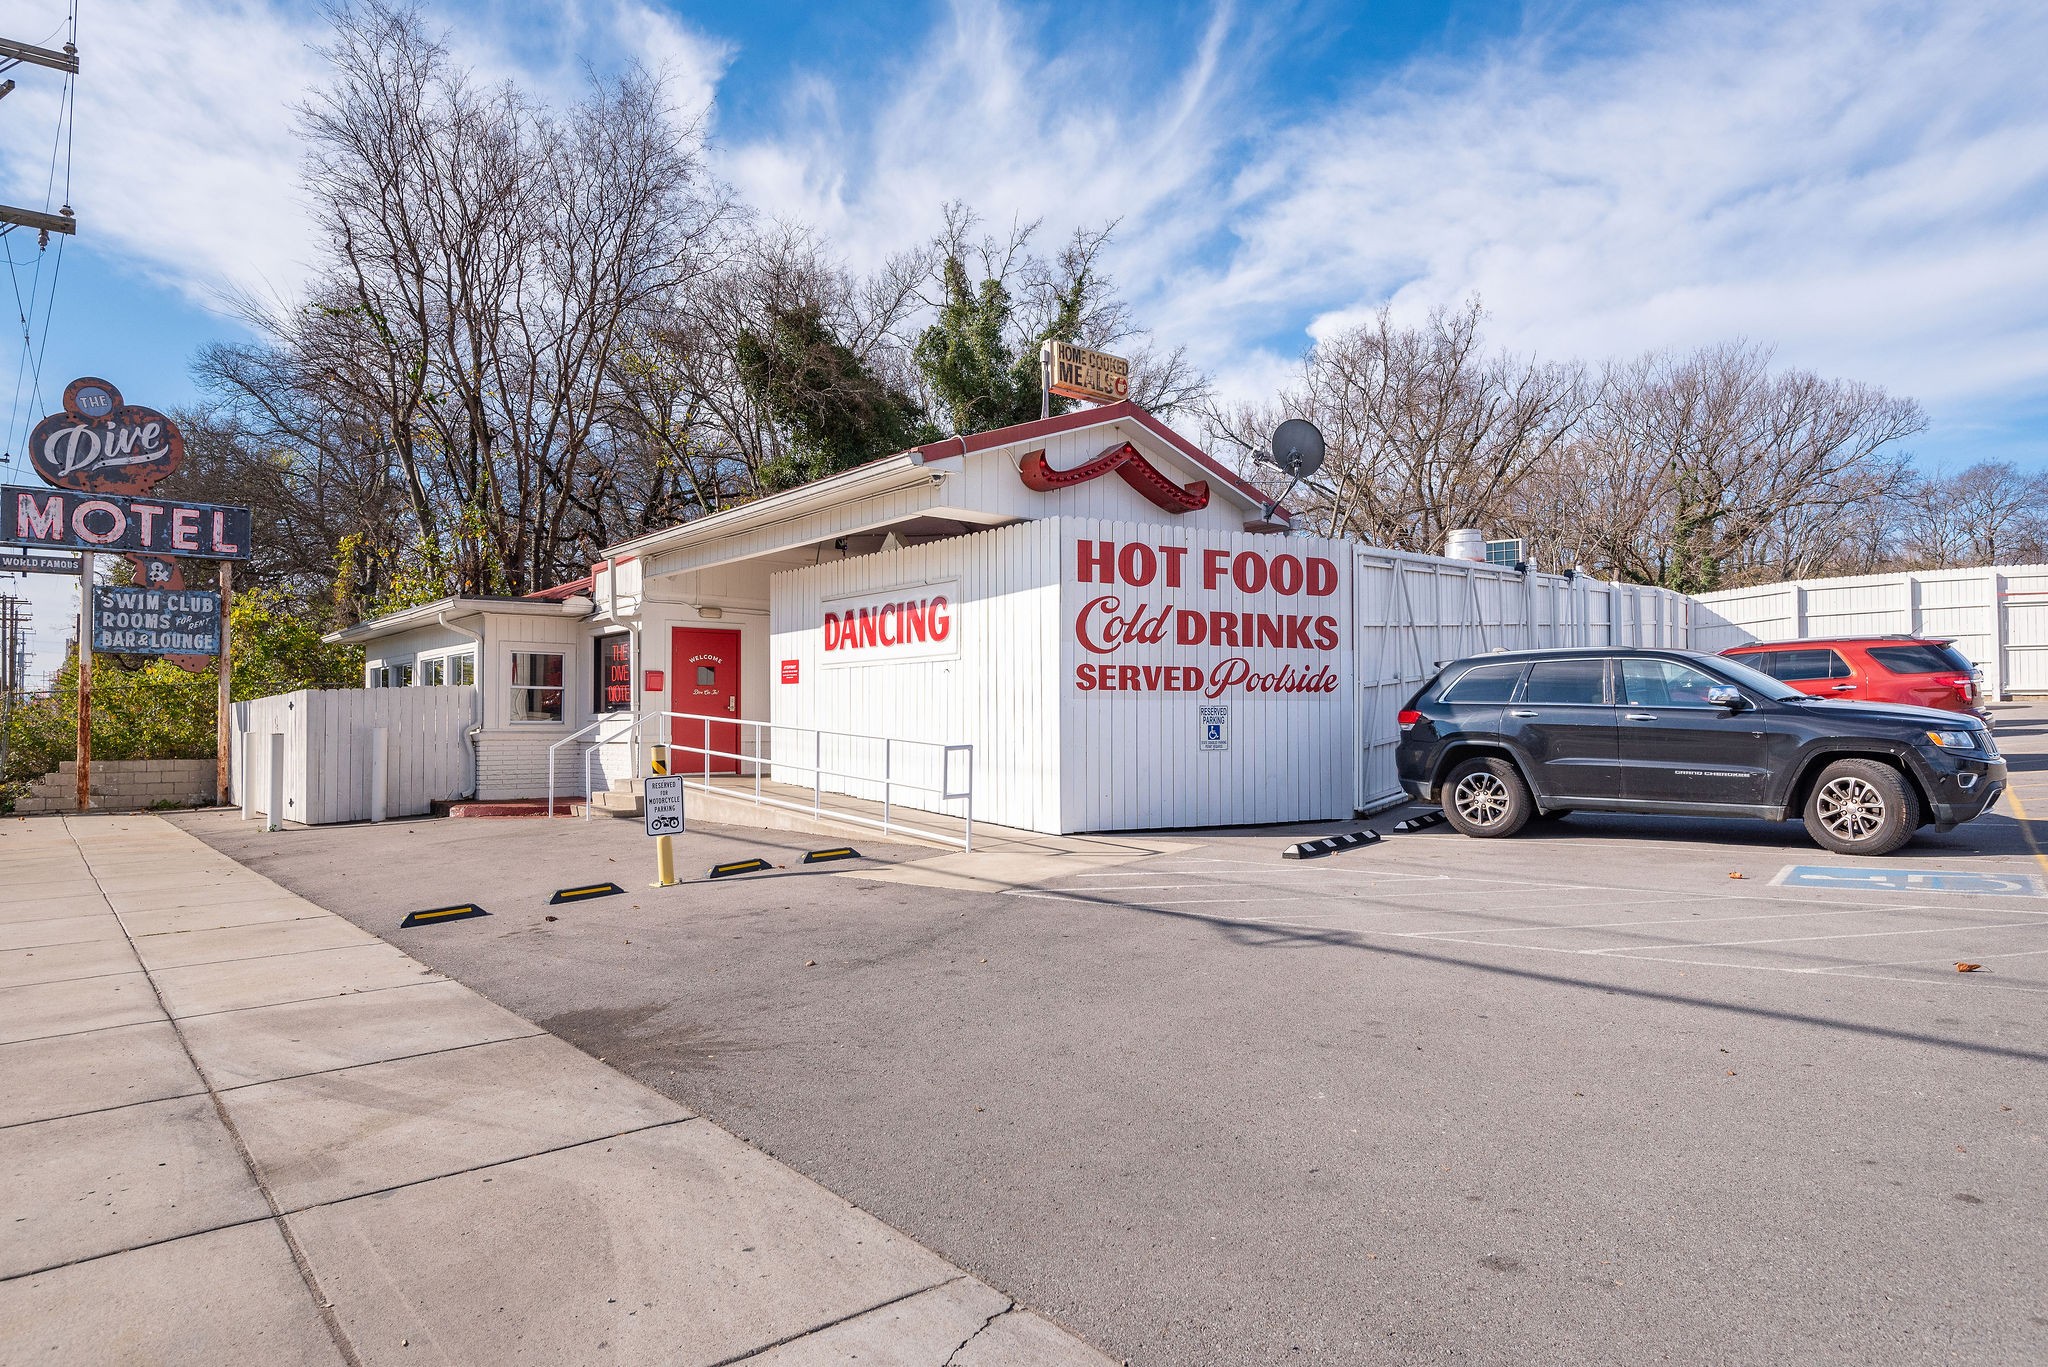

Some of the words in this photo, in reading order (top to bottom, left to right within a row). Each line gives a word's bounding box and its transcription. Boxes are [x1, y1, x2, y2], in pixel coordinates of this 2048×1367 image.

[1058, 344, 1087, 365] HOME
[1089, 353, 1129, 377] COOKED
[1059, 362, 1114, 394] MEALS
[79, 395, 108, 409] THE
[43, 421, 162, 477] Dive
[16, 493, 238, 554] MOTEL
[2, 557, 39, 568] WORLD
[40, 559, 79, 569] FAMOUS
[149, 562, 170, 582] &
[1077, 539, 1188, 588] HOT
[1203, 549, 1339, 597] FOOD
[101, 593, 160, 610] SWIM
[167, 595, 214, 613] CLUB
[102, 611, 172, 630] ROOMS
[175, 615, 193, 626] FOR
[187, 617, 211, 631] RENT
[824, 595, 951, 652] DANCING
[1075, 595, 1174, 655] Cold
[1176, 609, 1340, 651] DRINKS
[612, 643, 629, 661] THE
[688, 654, 723, 665] WELCOME
[1076, 663, 1205, 692] SERVED
[1204, 657, 1340, 699] Poolside
[1200, 707, 1227, 716] RESERVED
[1202, 715, 1225, 725] PARKING
[651, 781, 676, 789] RESERVED
[648, 796, 680, 805] MOTORCYCLE
[654, 805, 676, 813] PARKING
